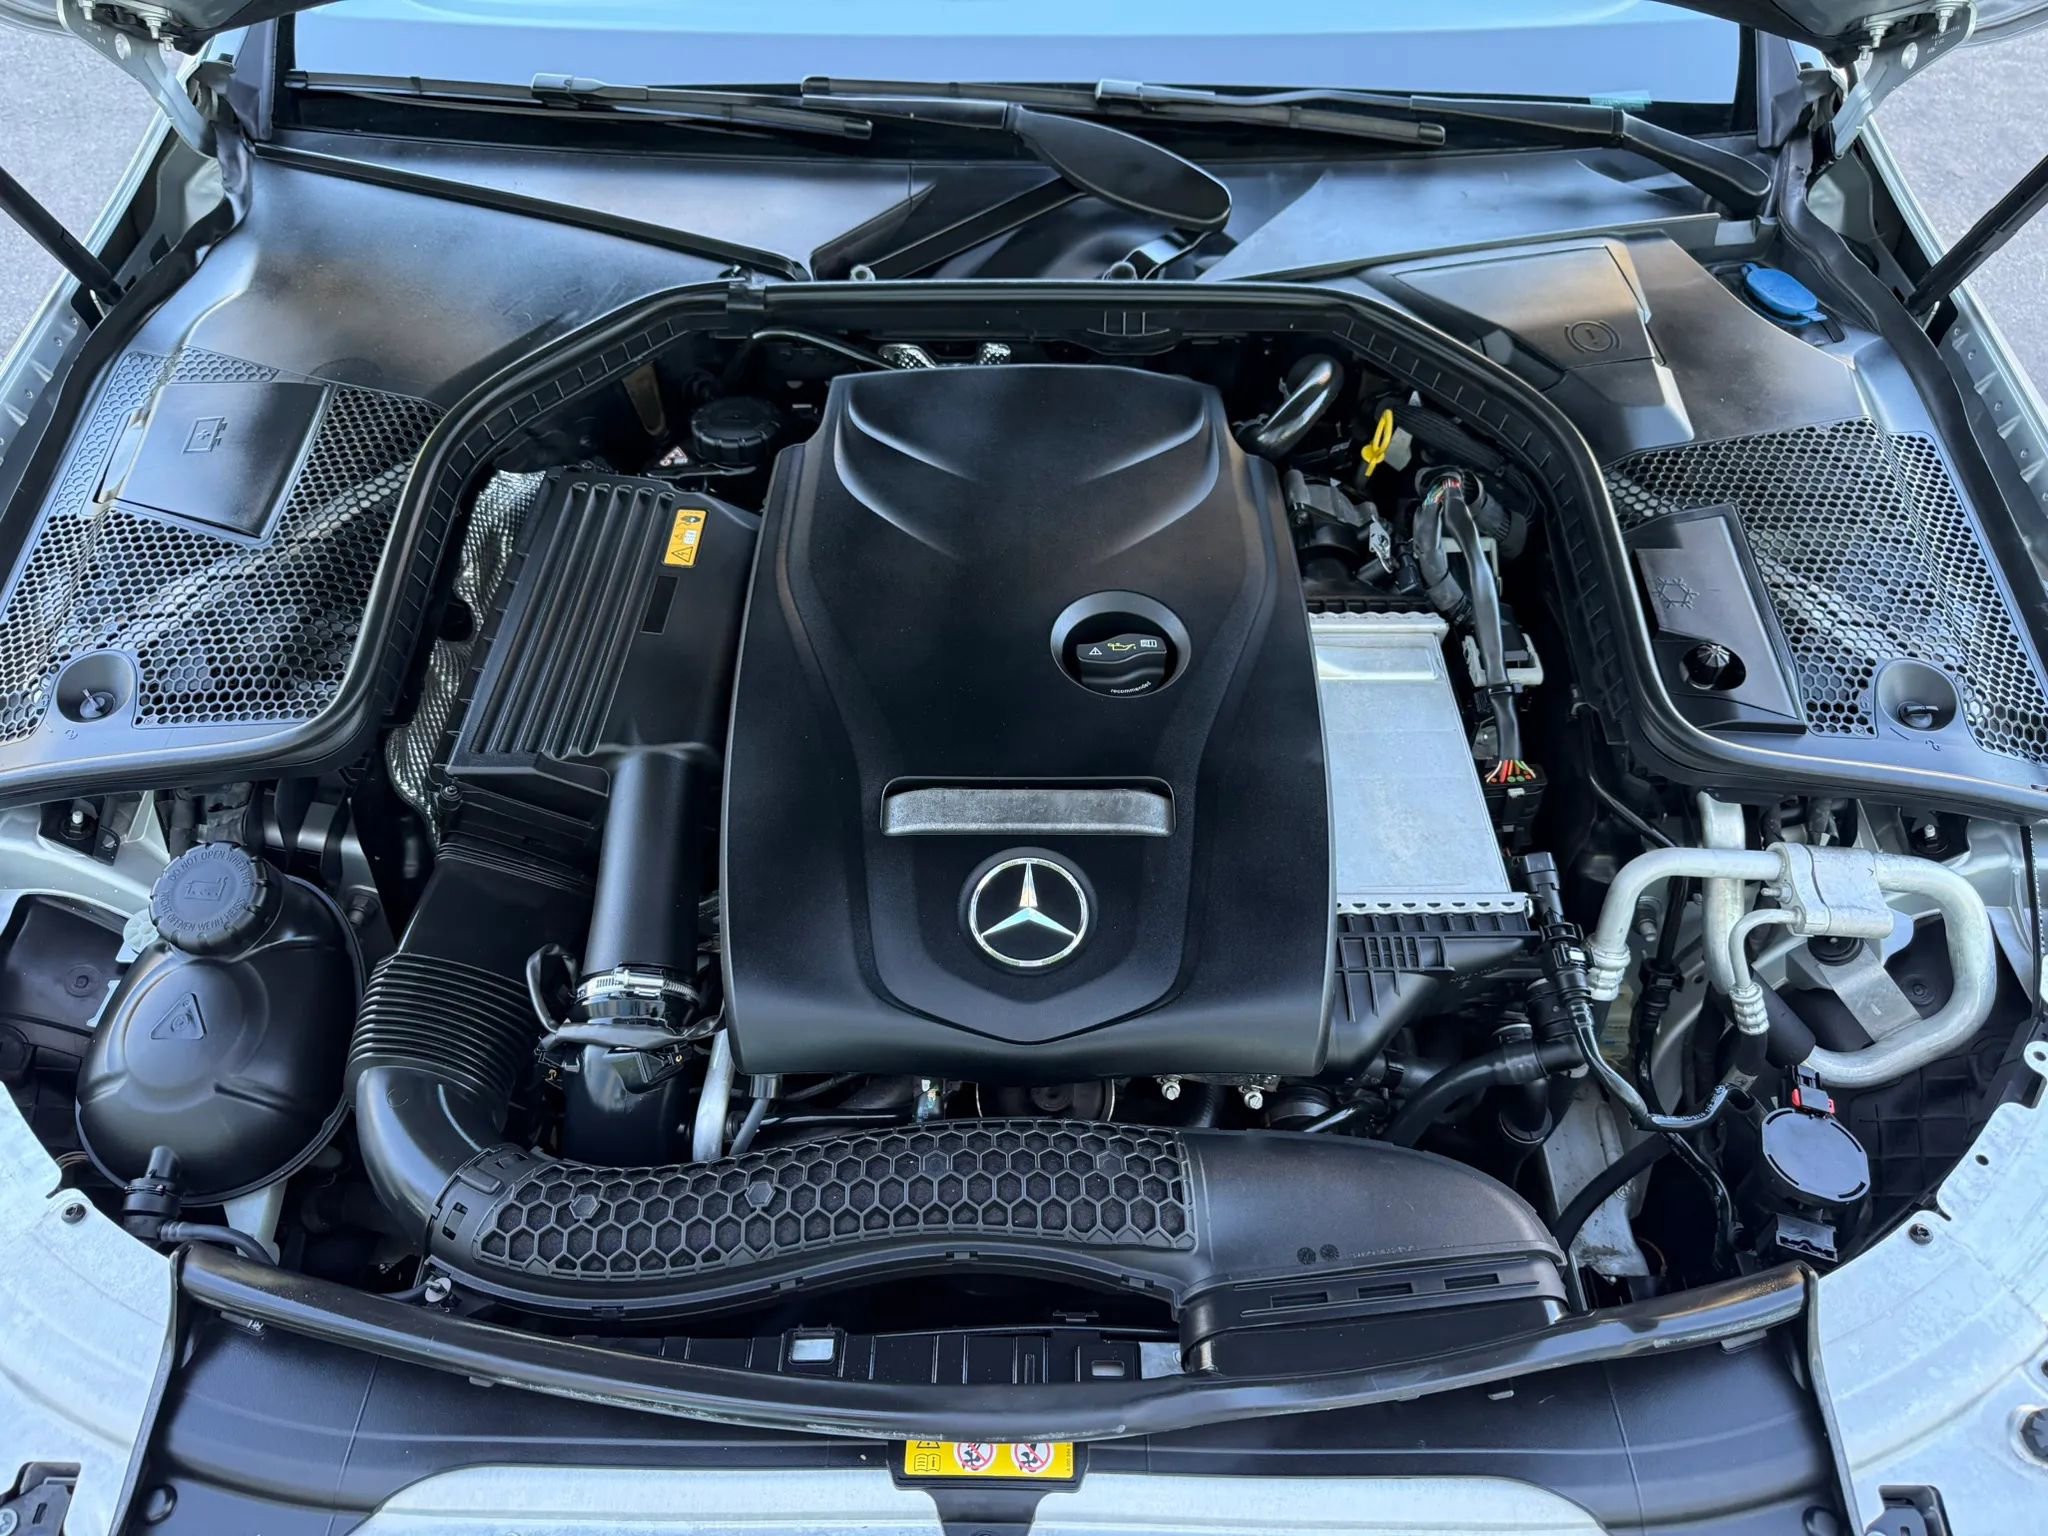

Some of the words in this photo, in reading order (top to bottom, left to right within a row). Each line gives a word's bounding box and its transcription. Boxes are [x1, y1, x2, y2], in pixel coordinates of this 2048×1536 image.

[168, 869, 180, 881] DO
[181, 855, 199, 871] NOT
[201, 850, 225, 860] OPEN
